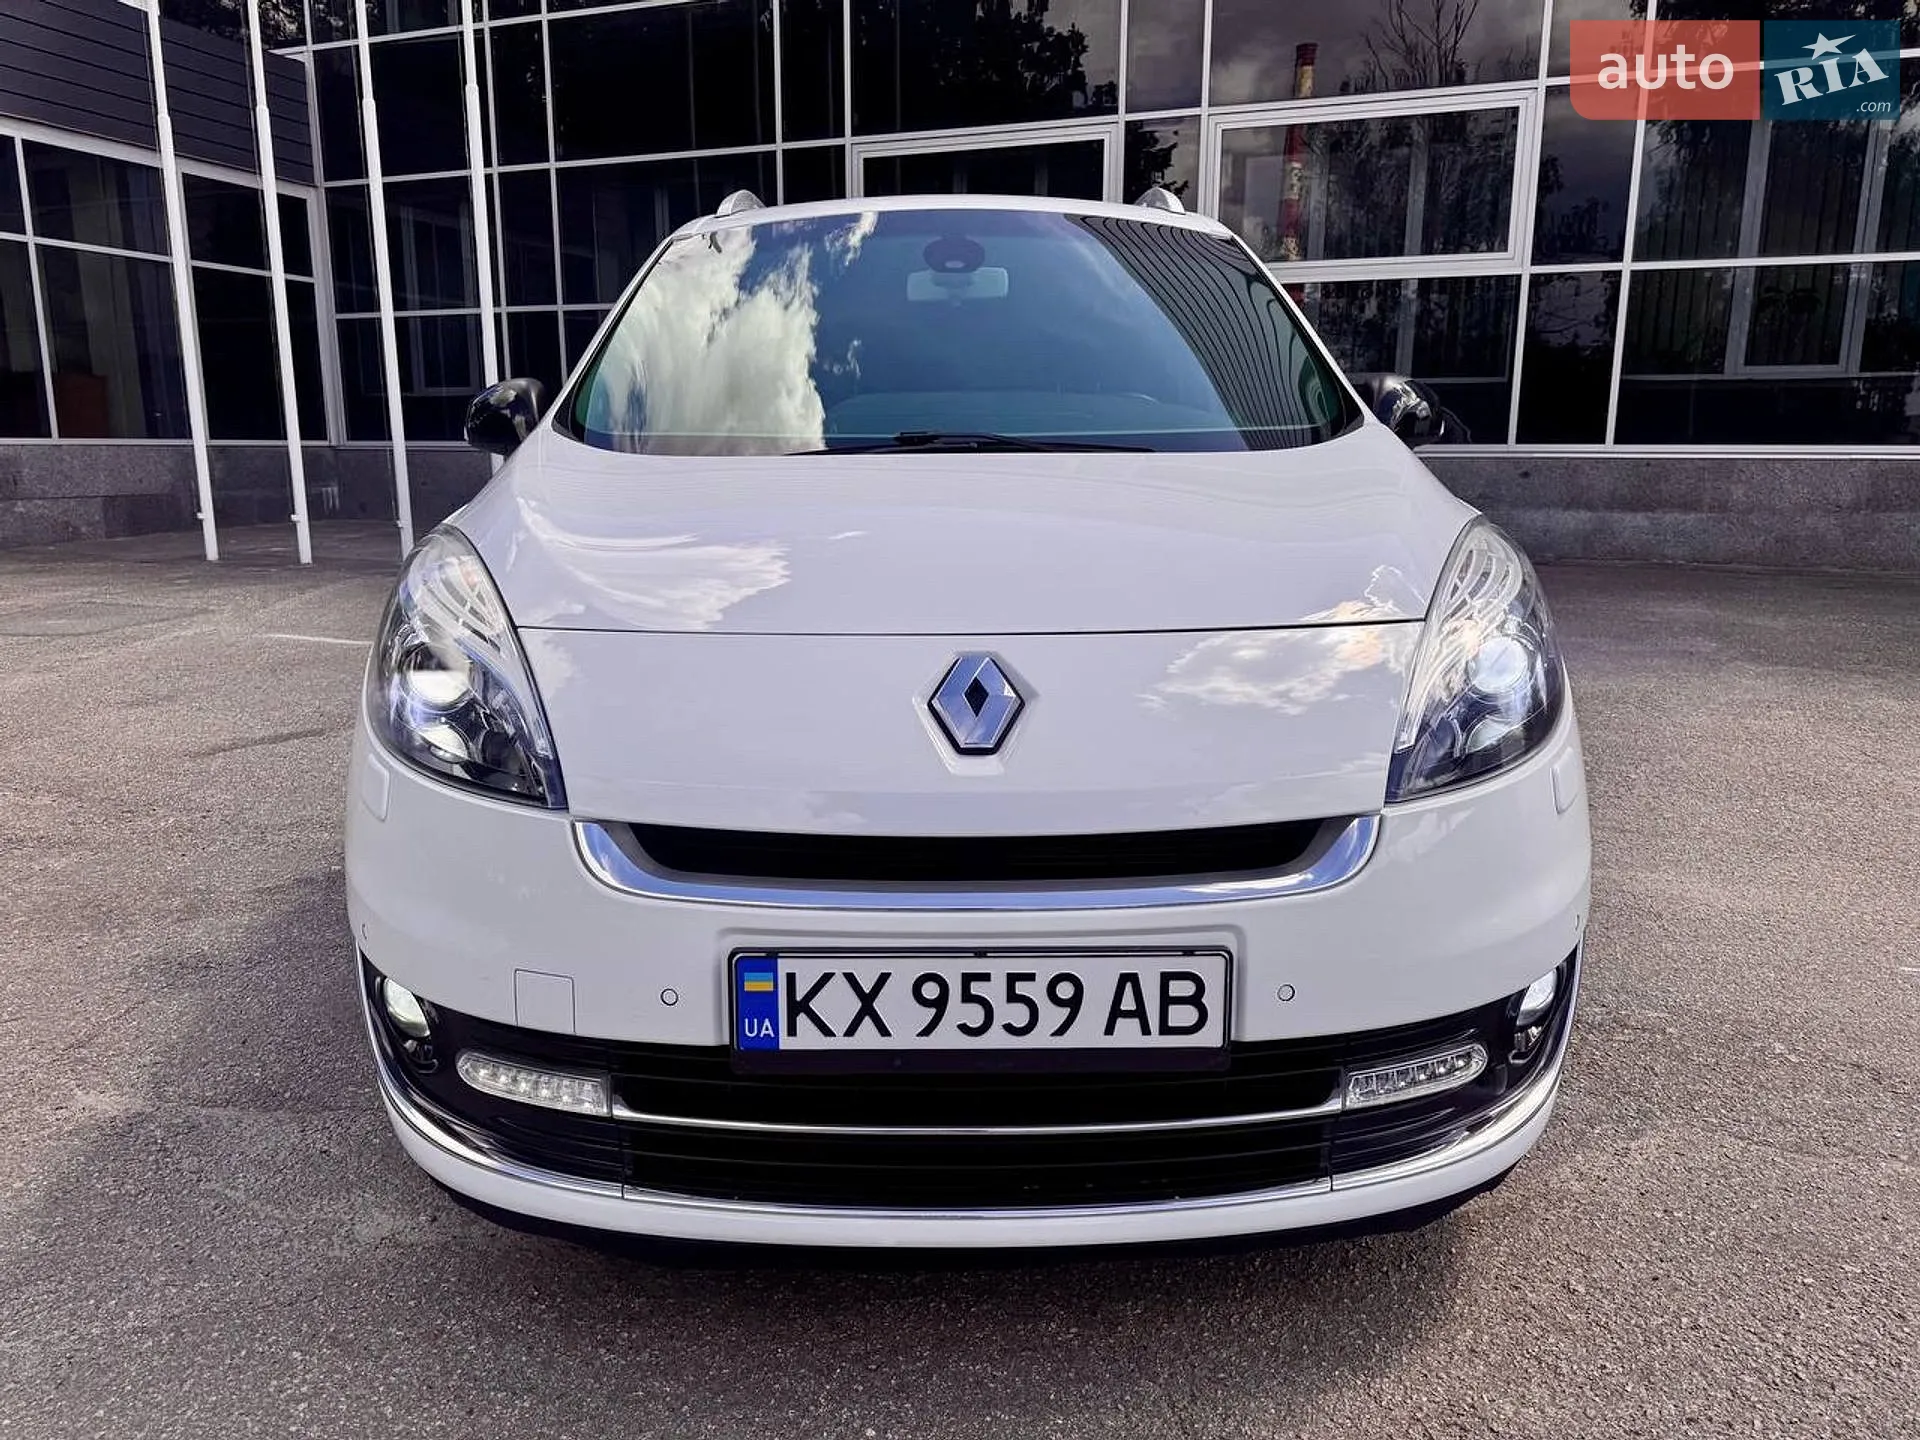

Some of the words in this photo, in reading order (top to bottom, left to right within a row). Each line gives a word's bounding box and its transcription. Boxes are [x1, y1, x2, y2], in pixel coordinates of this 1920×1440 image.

[785, 971, 893, 1038] KX
[911, 971, 1085, 1038] 9559
[1103, 971, 1209, 1036] AB
[744, 1017, 775, 1038] UA
